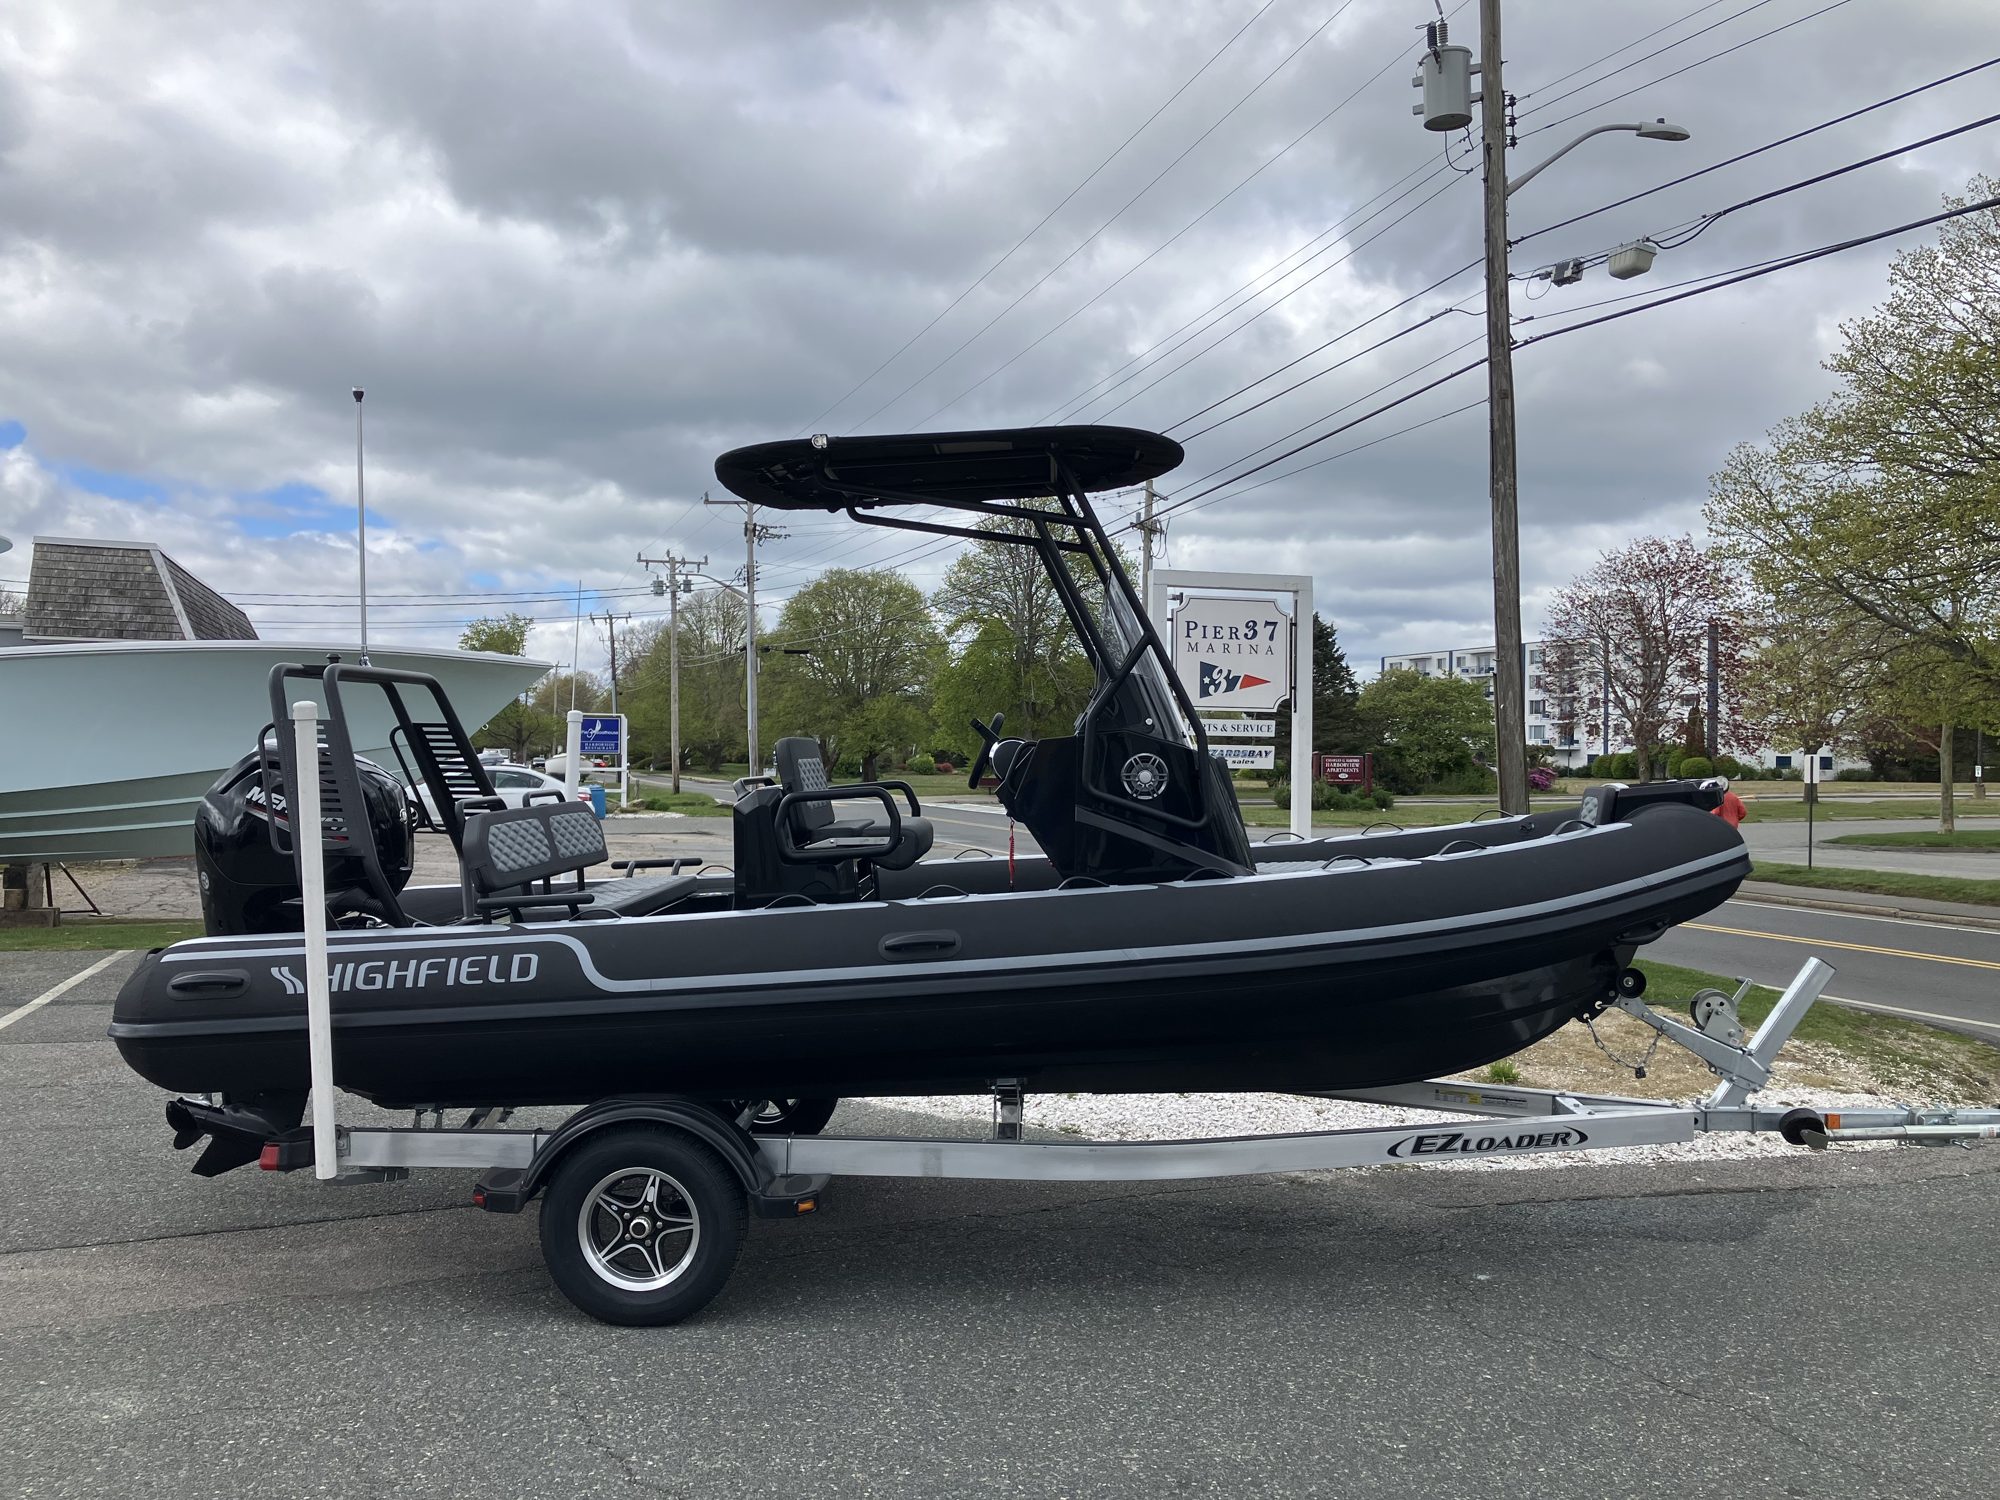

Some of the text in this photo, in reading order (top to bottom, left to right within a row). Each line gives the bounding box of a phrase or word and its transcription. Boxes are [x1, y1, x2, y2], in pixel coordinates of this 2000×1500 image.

[1187, 641, 1274, 655] MARINA
[1220, 723, 1228, 732] &
[1230, 723, 1273, 733] SERVICE
